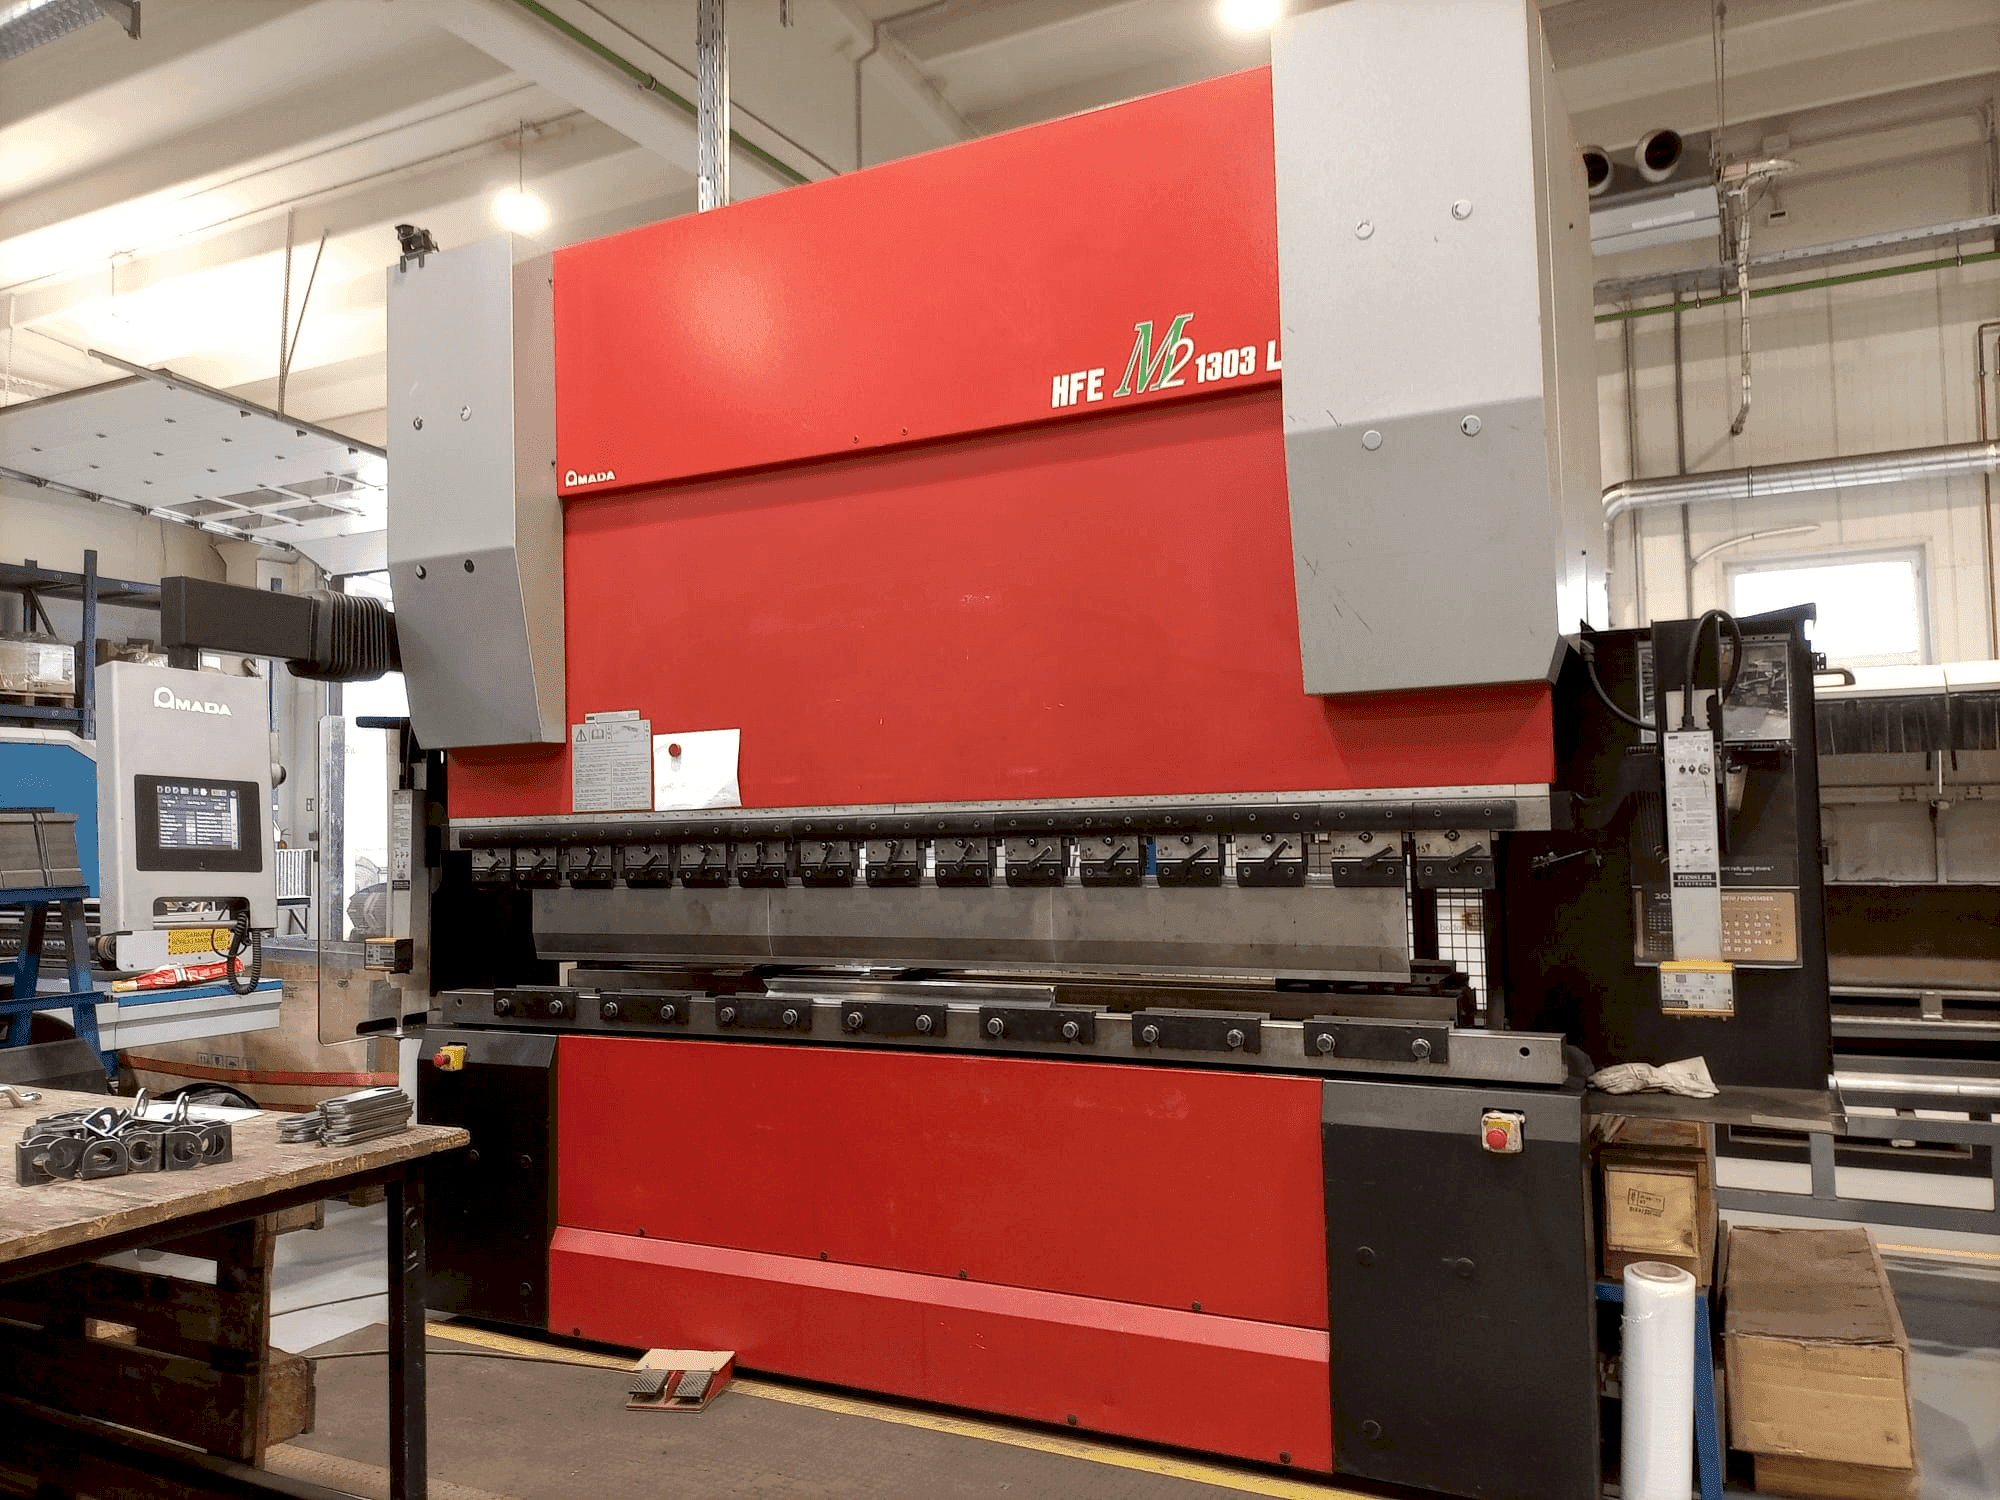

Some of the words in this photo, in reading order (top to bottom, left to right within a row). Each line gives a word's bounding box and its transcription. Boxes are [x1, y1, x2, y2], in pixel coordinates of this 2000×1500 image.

[1051, 368, 1105, 409] HFE
[1194, 345, 1257, 384] 1303
[565, 469, 616, 487] AMADA
[153, 686, 233, 717] AMADA
